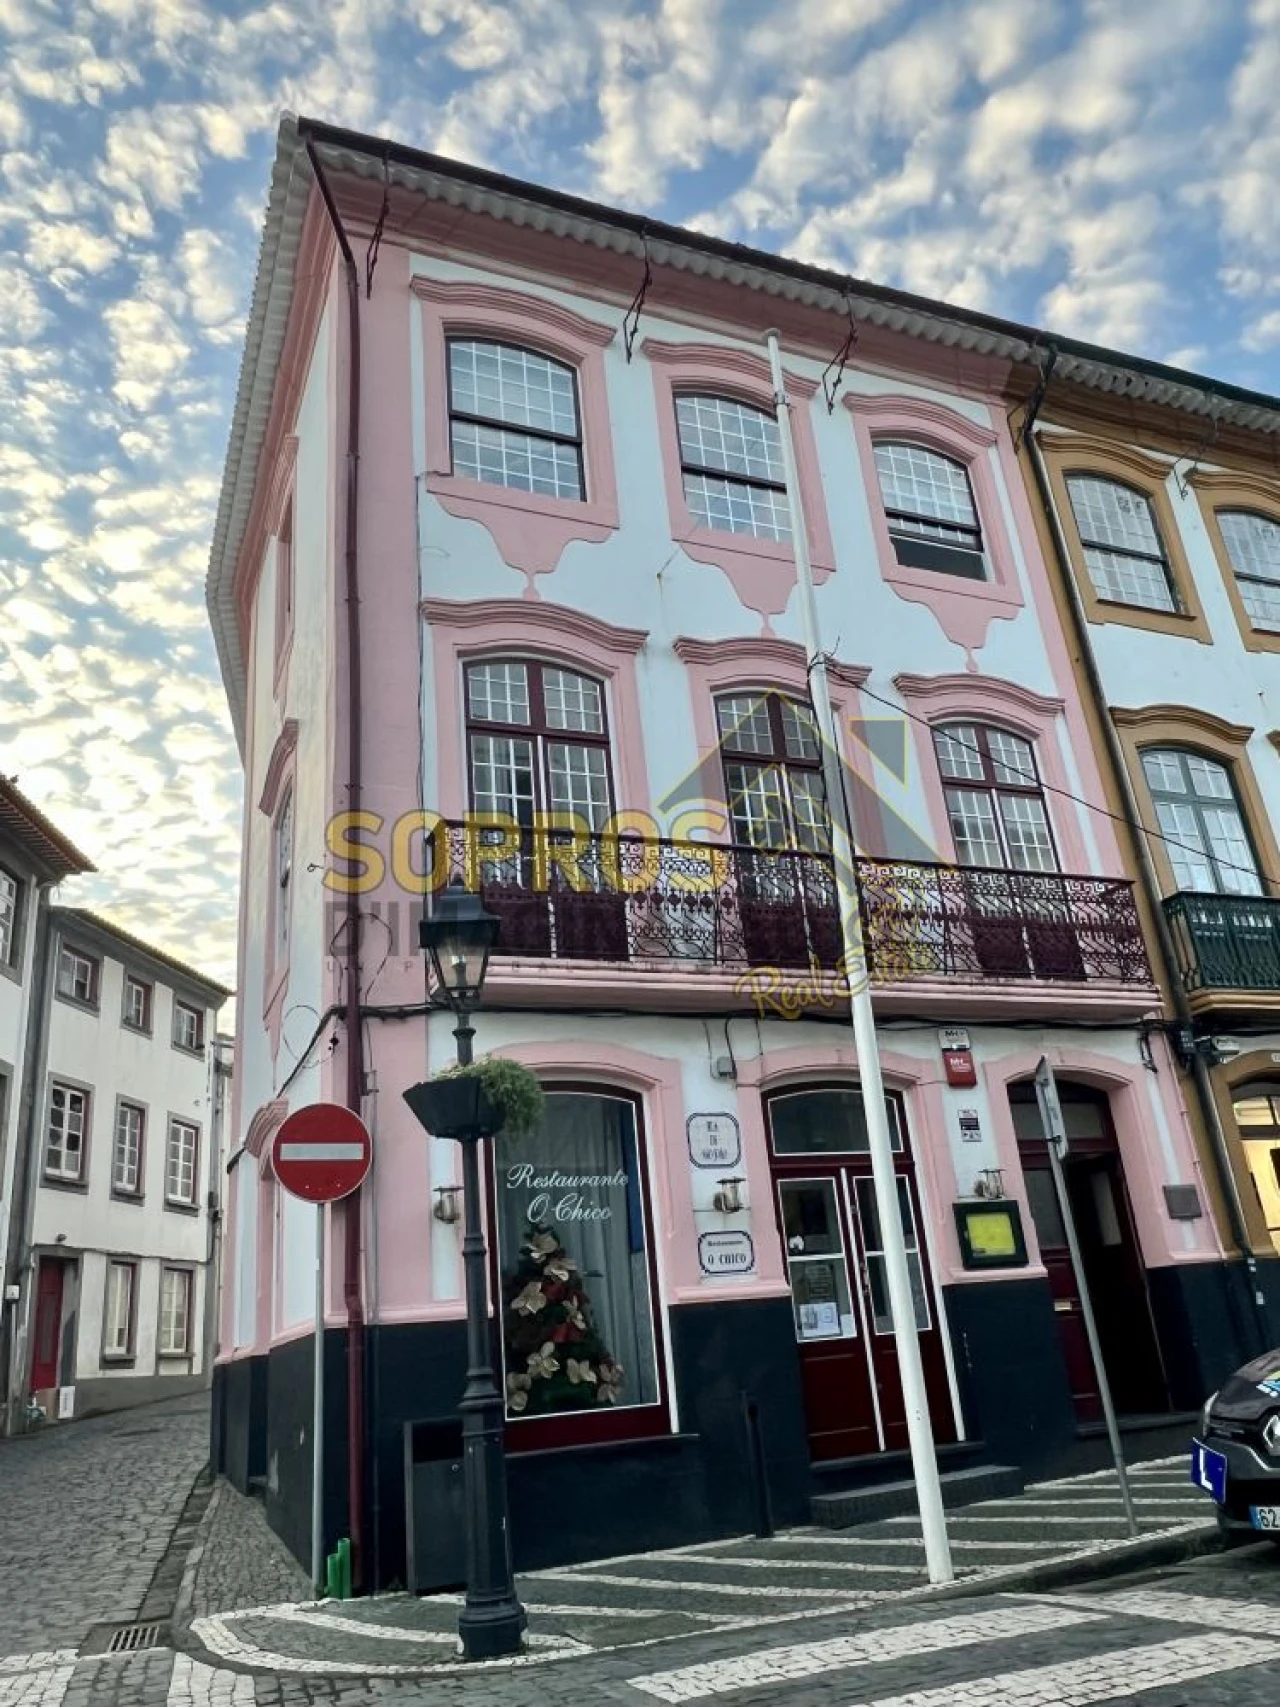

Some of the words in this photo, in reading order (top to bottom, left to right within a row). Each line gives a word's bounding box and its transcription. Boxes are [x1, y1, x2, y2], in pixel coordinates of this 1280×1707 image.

[507, 1163, 628, 1189] Restaurante
[527, 1193, 550, 1223] O
[551, 1192, 611, 1221] Chico
[719, 1252, 747, 1265] CHICO
